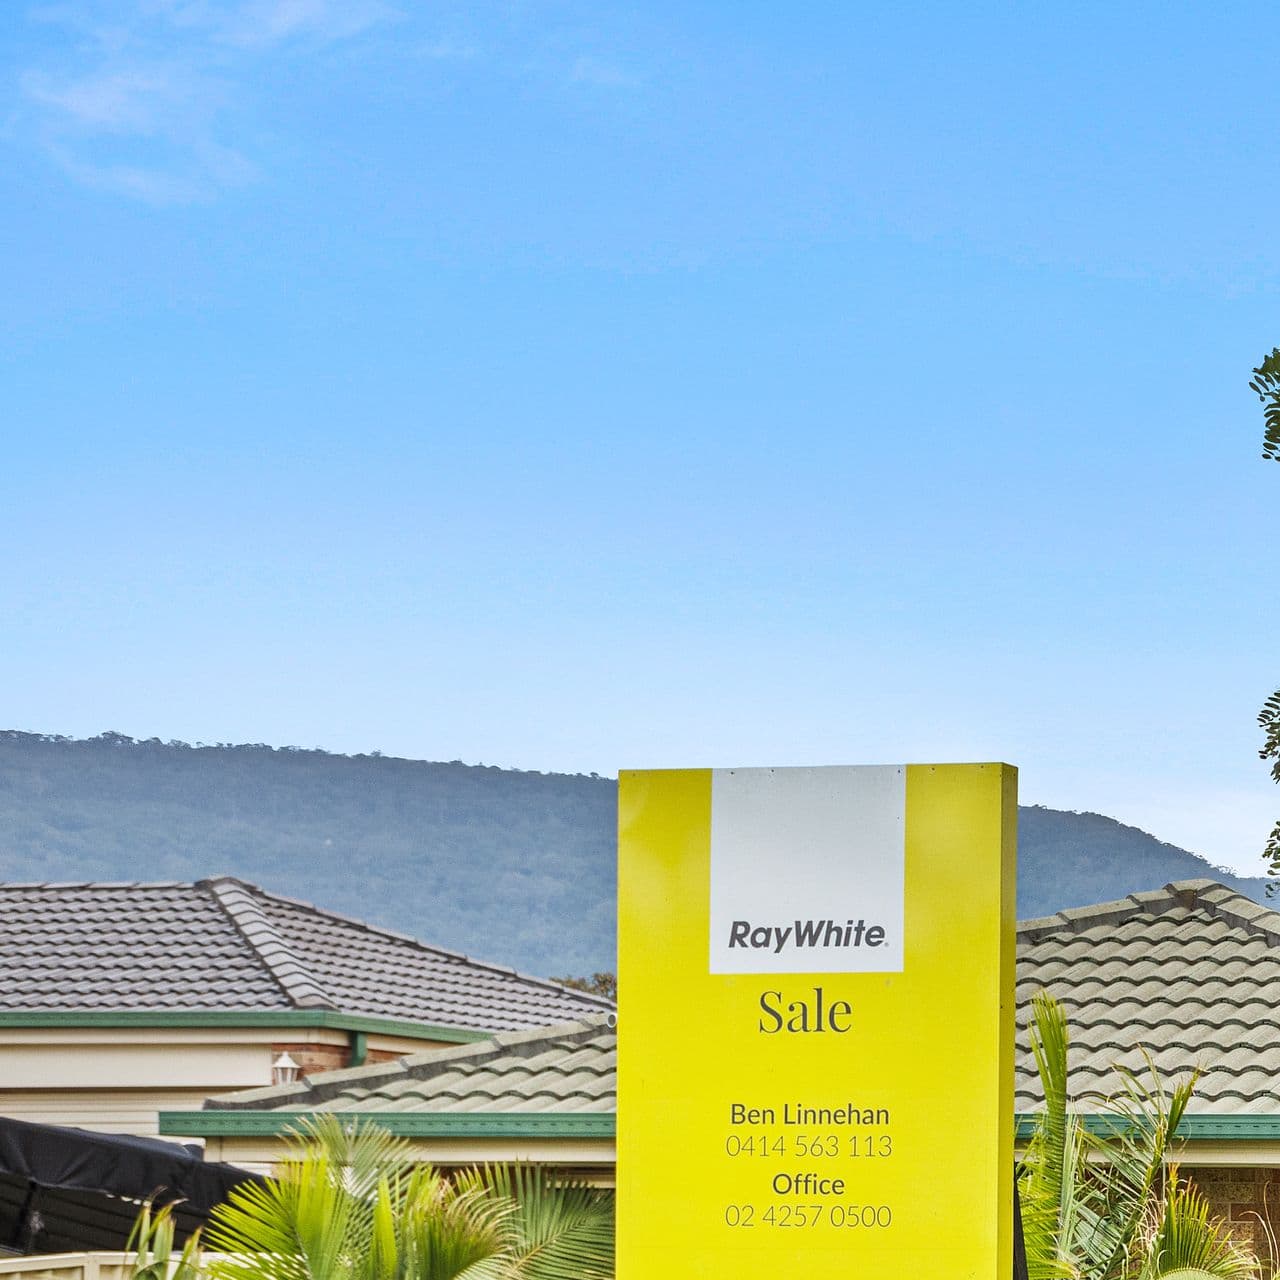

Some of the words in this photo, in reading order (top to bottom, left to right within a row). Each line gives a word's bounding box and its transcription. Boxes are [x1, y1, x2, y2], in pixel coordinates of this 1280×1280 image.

[759, 987, 852, 1034] Sale
[731, 1102, 775, 1125] Ben
[783, 1102, 889, 1125] Linnehan
[726, 1135, 787, 1158] 0414
[794, 1135, 839, 1158] 563
[848, 1135, 892, 1158] 113
[772, 1172, 845, 1196] Office
[725, 1204, 755, 1228] 02
[762, 1204, 823, 1228] 4257
[830, 1204, 892, 1228] 0500
